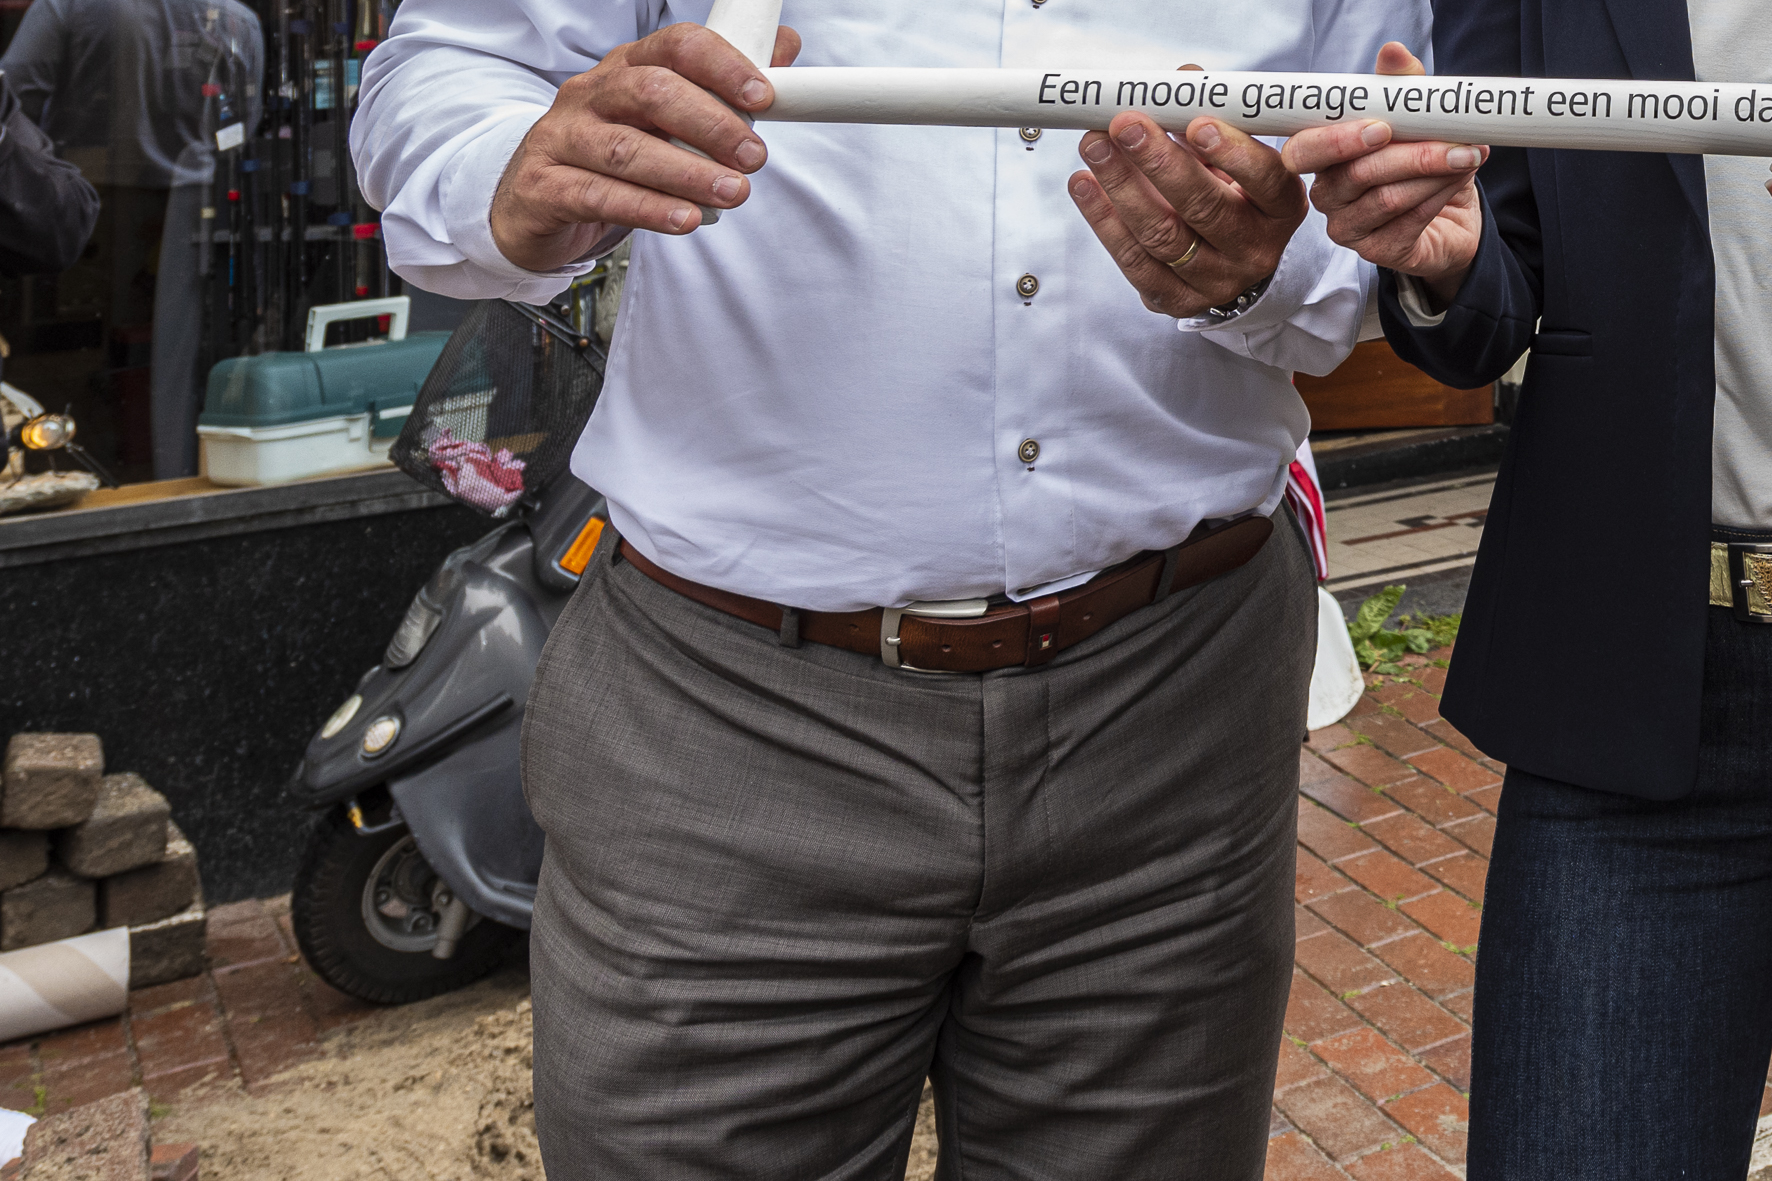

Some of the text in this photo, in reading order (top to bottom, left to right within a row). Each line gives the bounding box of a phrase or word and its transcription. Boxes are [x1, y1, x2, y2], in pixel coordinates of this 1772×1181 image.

[1037, 73, 1101, 106] Een
[1116, 75, 1228, 108] mooie
[1241, 81, 1369, 120] garage
[1382, 81, 1535, 116] verdient
[1546, 90, 1612, 118] een
[1626, 89, 1719, 121] mooi
